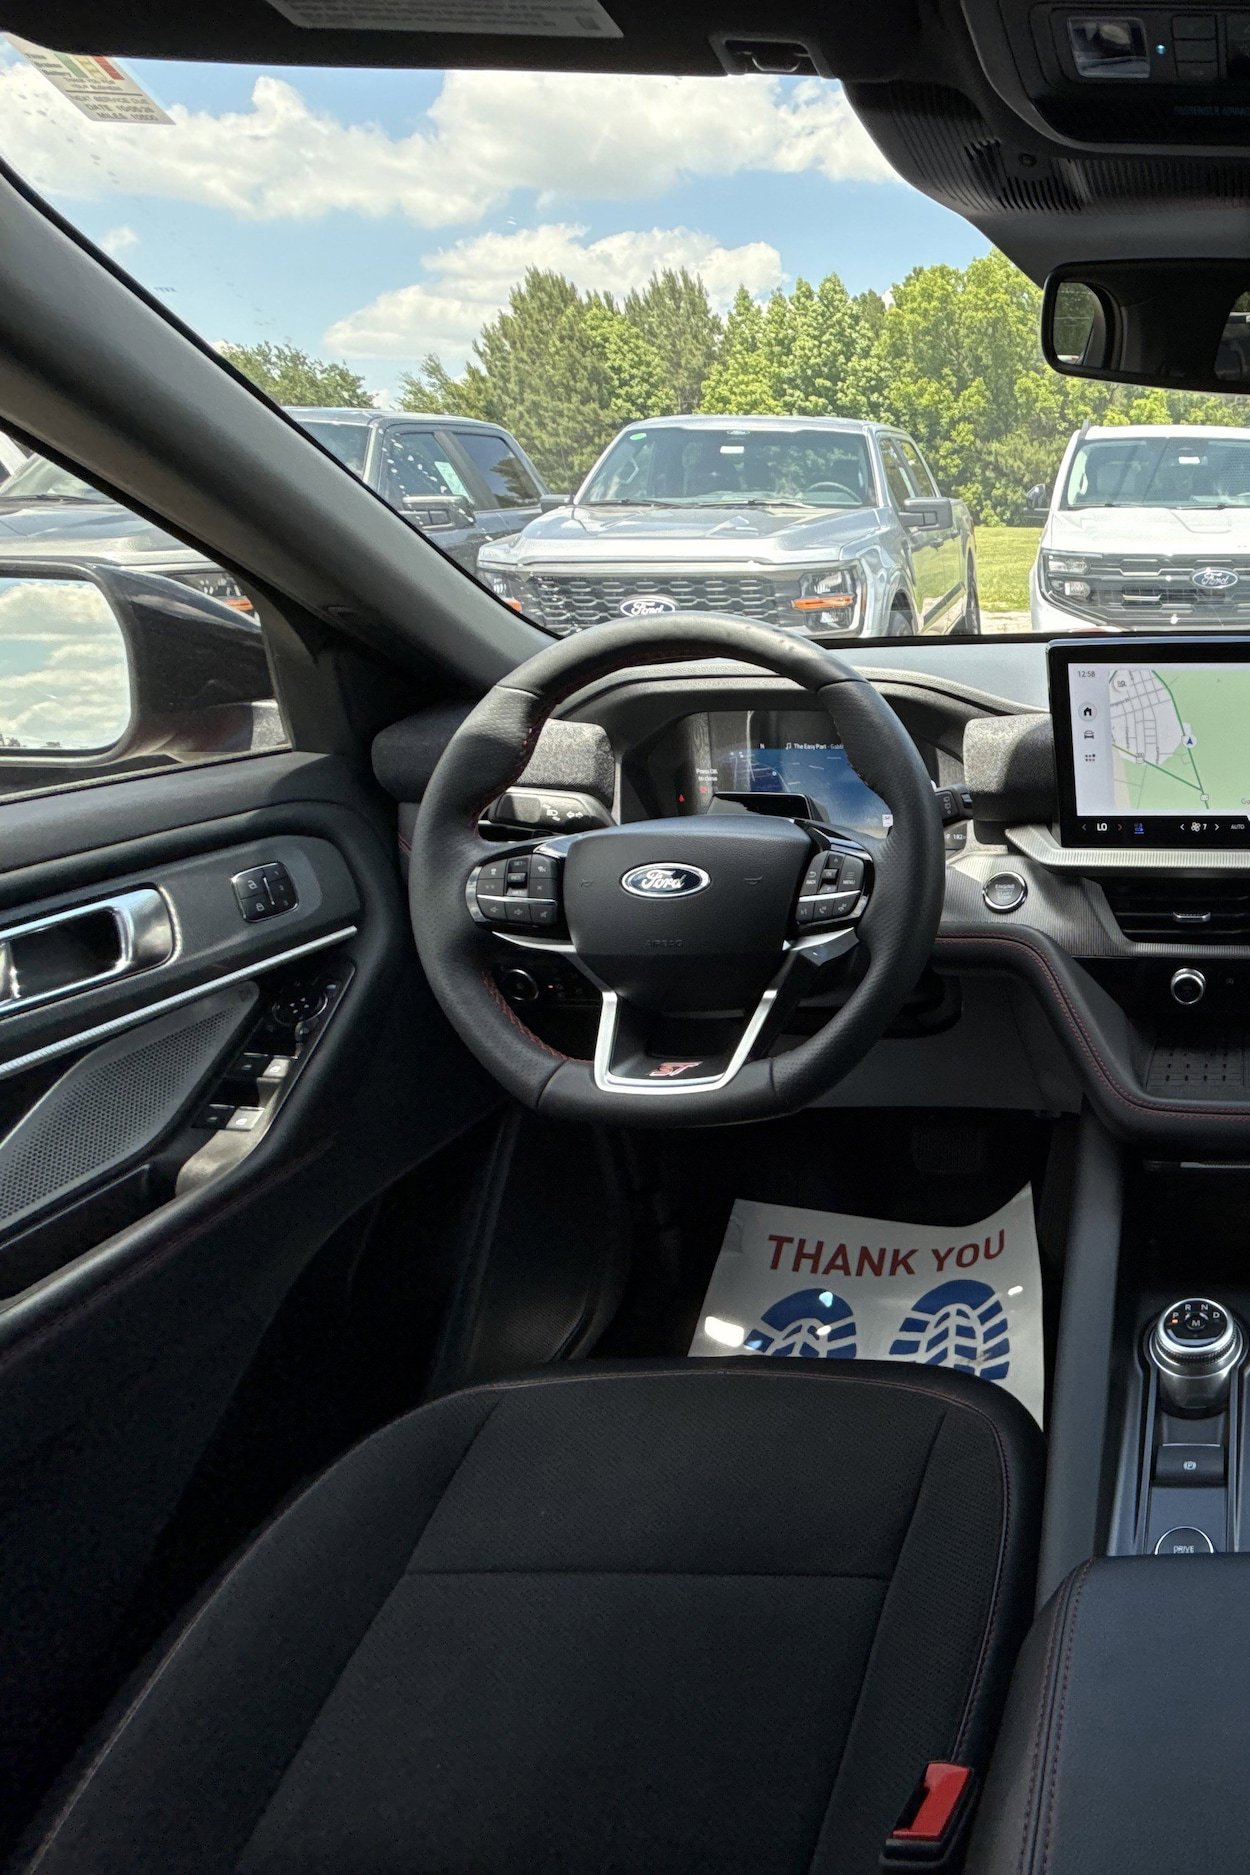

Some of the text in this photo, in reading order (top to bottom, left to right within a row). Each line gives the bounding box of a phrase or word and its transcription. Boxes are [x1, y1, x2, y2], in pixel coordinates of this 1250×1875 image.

[1078, 670, 1096, 678] 12:58
[803, 743, 815, 751] Easy
[1096, 822, 1108, 831] LO
[767, 1229, 1006, 1277] THANK YOU
[1184, 1303, 1209, 1311] R N
[1172, 1311, 1220, 1319] P D
[1191, 1319, 1201, 1327] M
